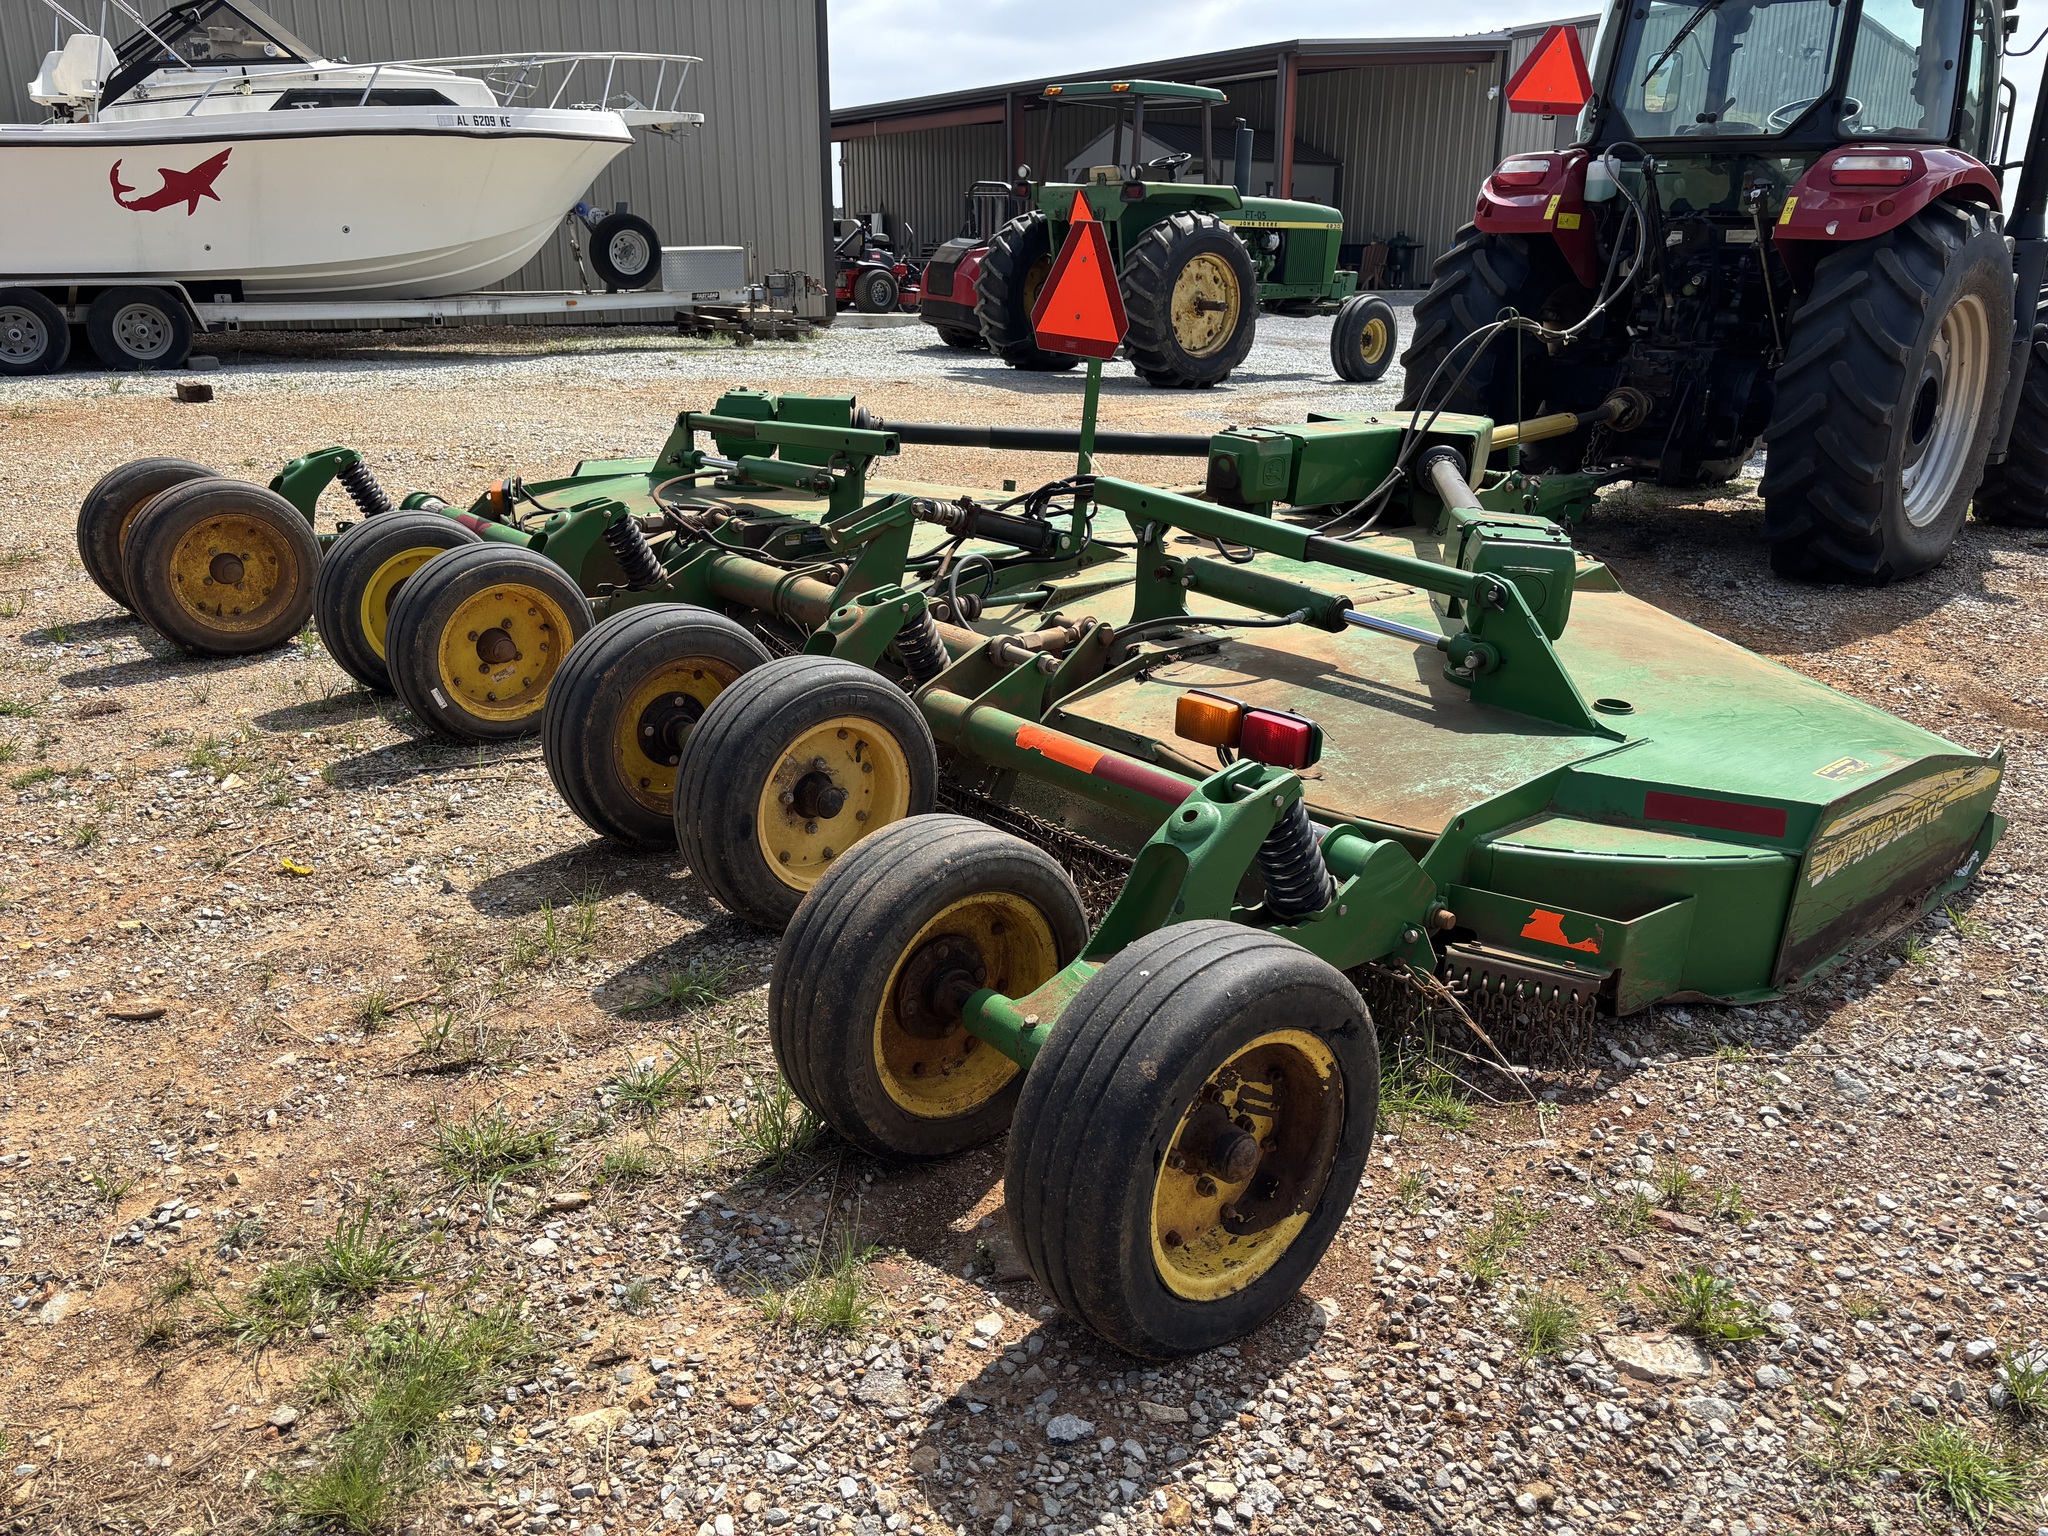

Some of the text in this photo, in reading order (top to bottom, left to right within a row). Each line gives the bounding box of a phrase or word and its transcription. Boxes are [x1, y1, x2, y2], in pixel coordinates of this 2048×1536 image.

[457, 115, 469, 126] AL
[472, 115, 496, 127] 6209
[499, 116, 511, 127] KE
[1245, 210, 1267, 220] FT-05
